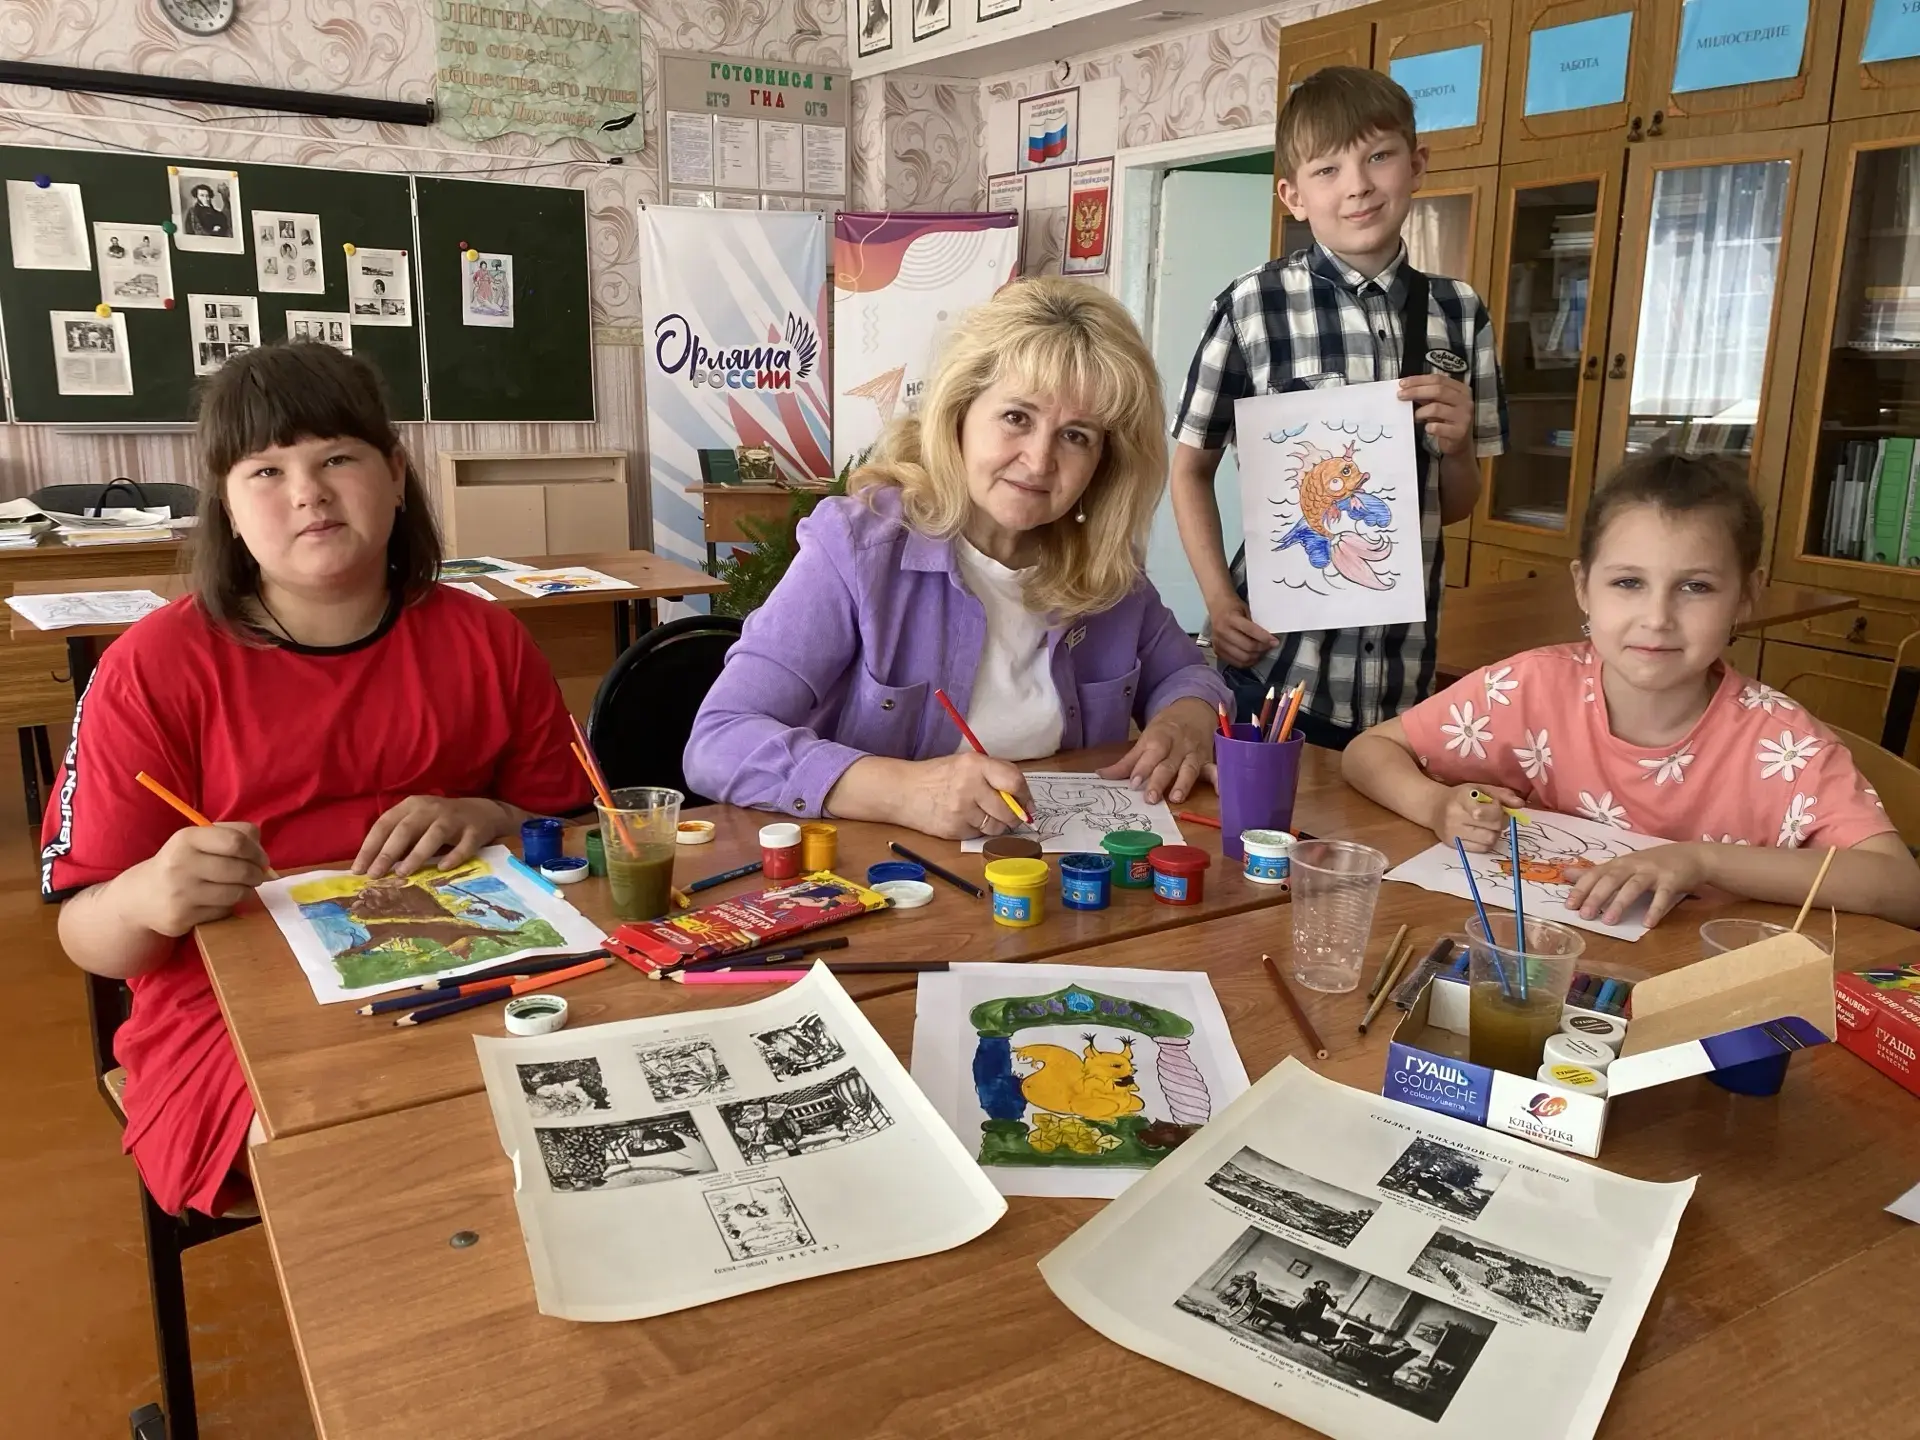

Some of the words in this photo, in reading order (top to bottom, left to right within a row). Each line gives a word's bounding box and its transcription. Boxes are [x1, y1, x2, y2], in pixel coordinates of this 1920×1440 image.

[442, 2, 612, 45] ЛИТЕРАТУРА
[1696, 24, 1791, 50] МИЛОСЕРДИЕ
[486, 43, 575, 70] совесть
[1559, 56, 1600, 73] ЗАБОТА
[710, 62, 813, 90] ГОТОВИМСЯ
[824, 76, 834, 91] К
[551, 80, 580, 97] его
[584, 85, 638, 105] душа
[706, 91, 731, 107] ЕГЭ
[750, 89, 786, 108] ГИА
[805, 101, 828, 117] ОГЭ
[654, 313, 792, 382] Орлята
[692, 369, 792, 390] РОССИИ
[1837, 990, 1871, 1016] BRAUBERG
[1875, 1026, 1916, 1061] ГУАШЬ
[1877, 1043, 1909, 1067] ПРЕМИУМ
[1404, 1056, 1470, 1086] ГУАШЬ
[1876, 1050, 1910, 1074] КАЧЕСТВО
[1394, 1070, 1478, 1105] GOUACHE
[1370, 1113, 1412, 1131] ССЫЛКА
[1426, 1133, 1514, 1166] МИХАЙЛОВСКОЕ
[1508, 1116, 1574, 1143] классика
[776, 1243, 840, 1262] СКАЗКИ
